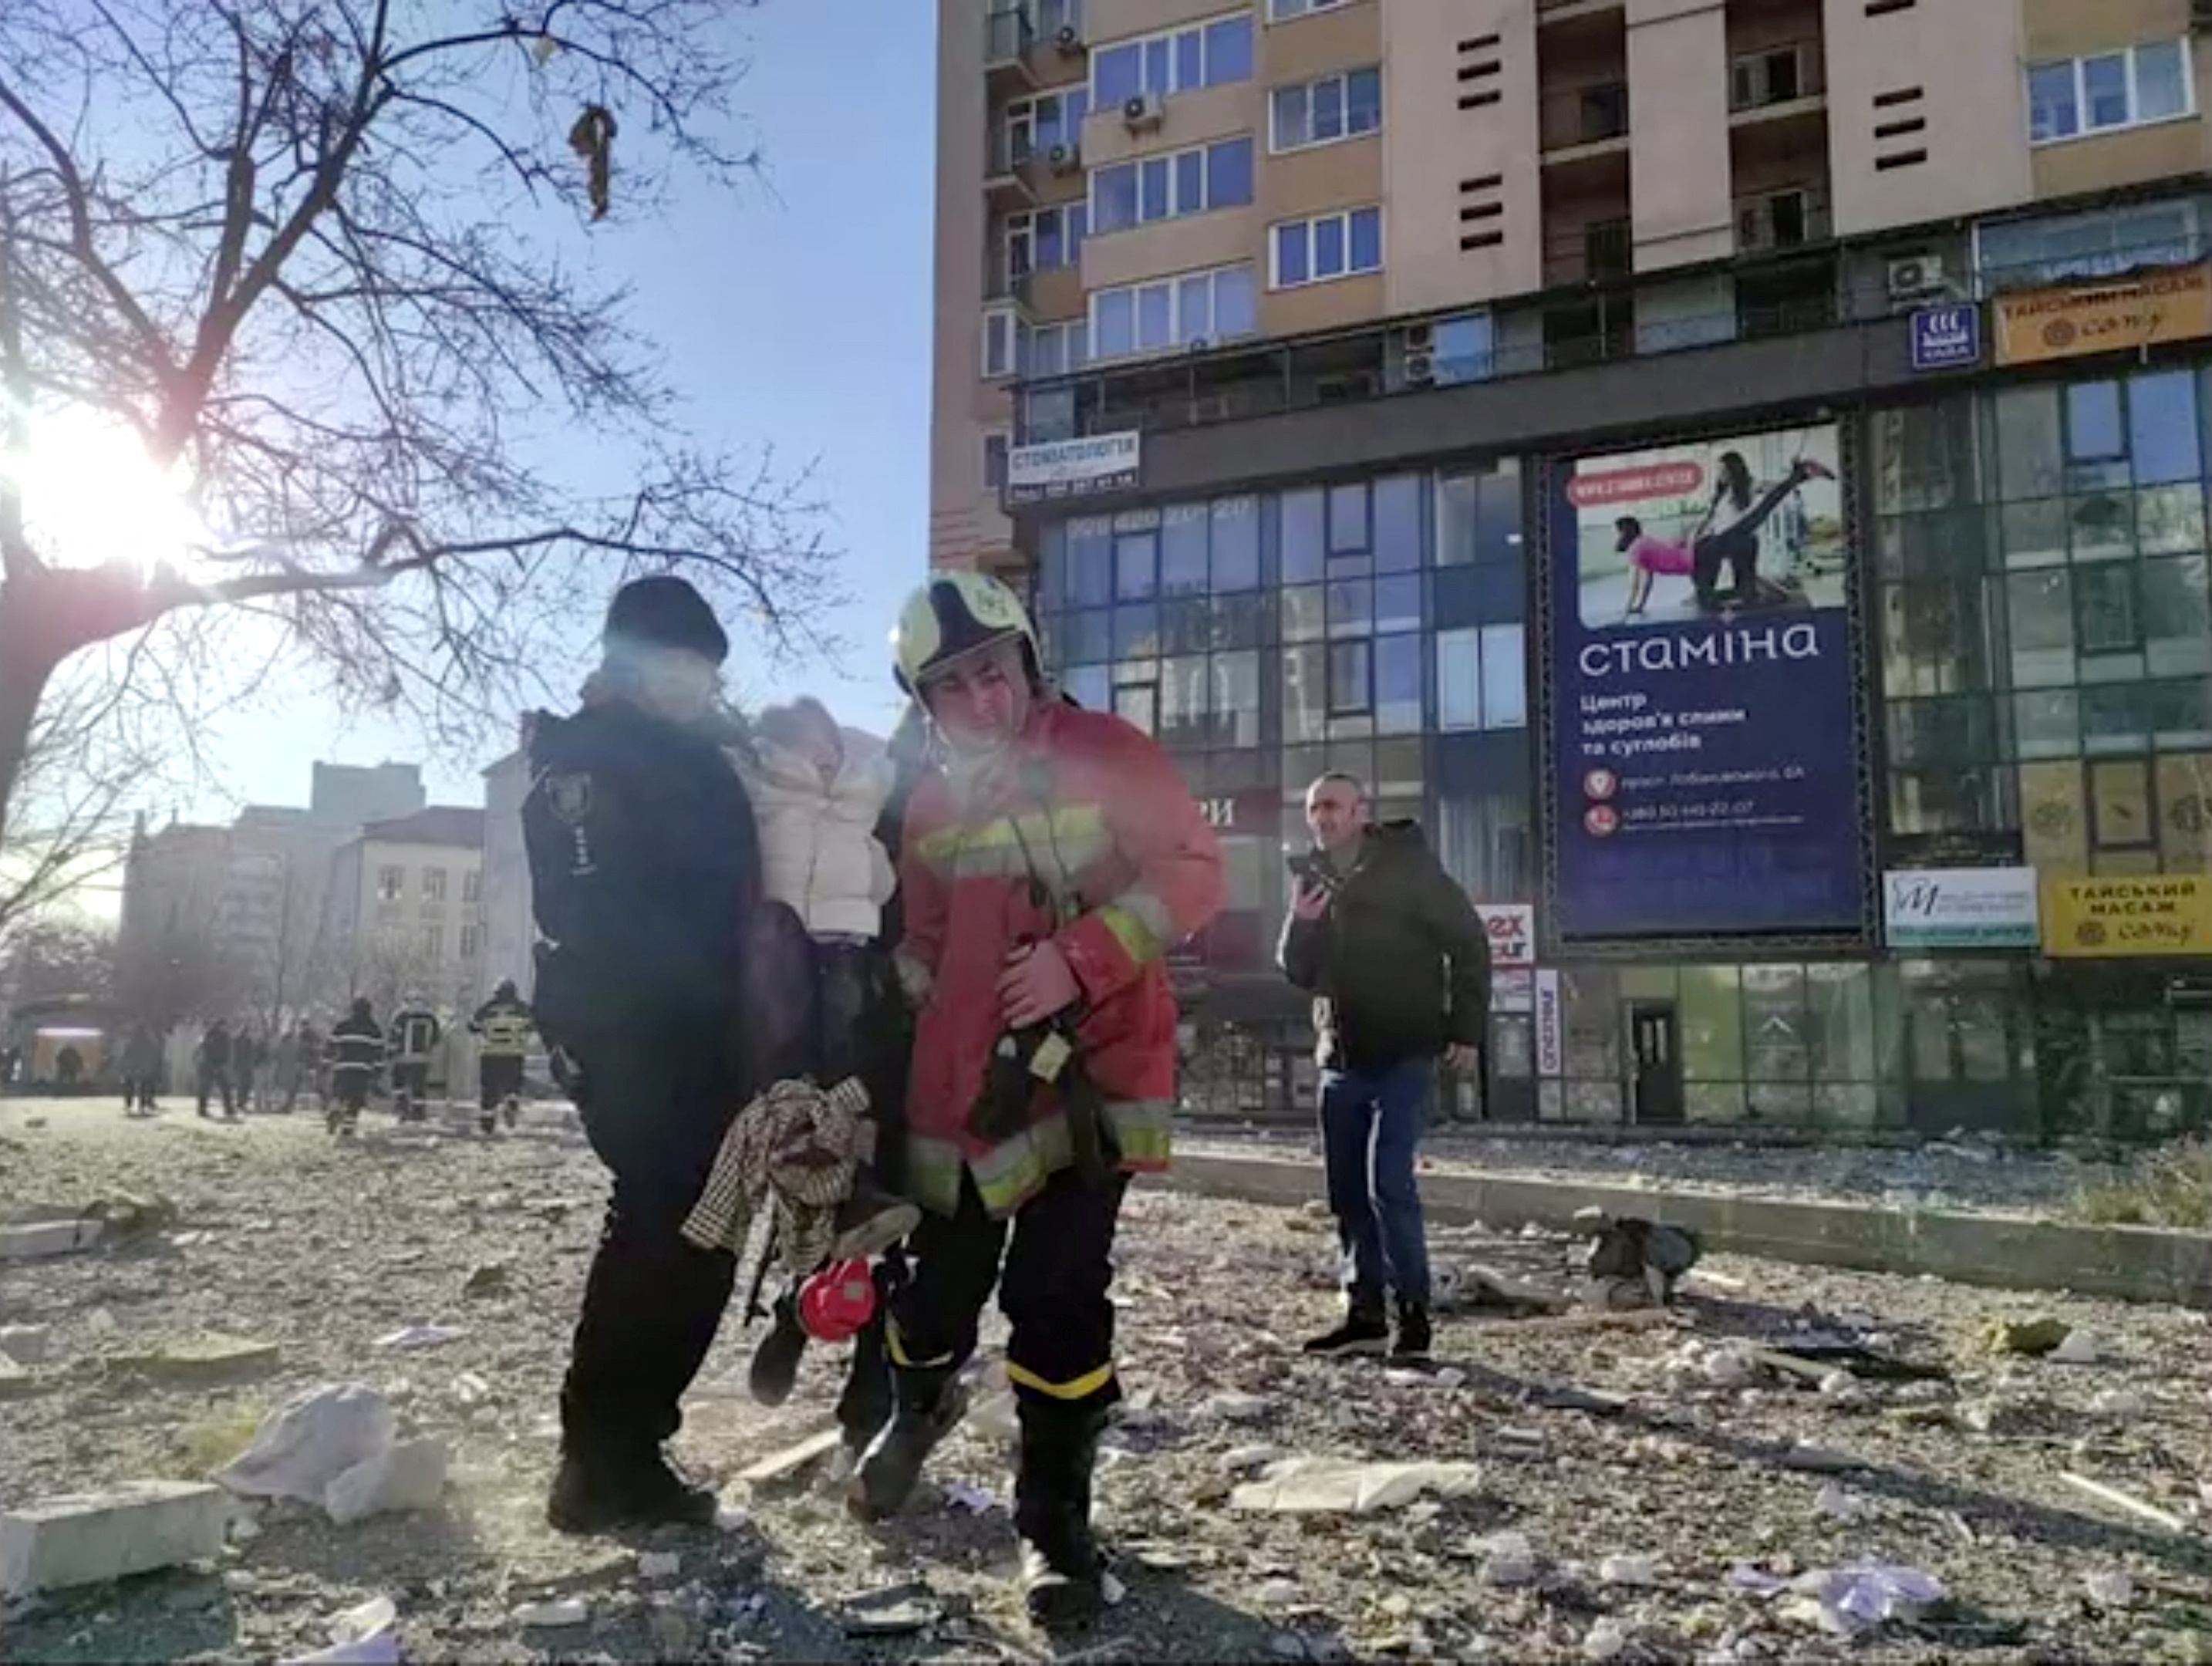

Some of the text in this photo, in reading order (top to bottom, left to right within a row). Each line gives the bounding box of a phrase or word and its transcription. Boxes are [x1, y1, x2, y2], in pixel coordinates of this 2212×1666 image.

[1011, 437, 1135, 470] СТОМАТОЛОГІЯ
[1581, 693, 1647, 713] Центр
[1583, 734, 1702, 757] та суглобів
[2070, 881, 2196, 899] ТАЙСЬКИЙ
[2090, 901, 2175, 916] МАСАЖ
